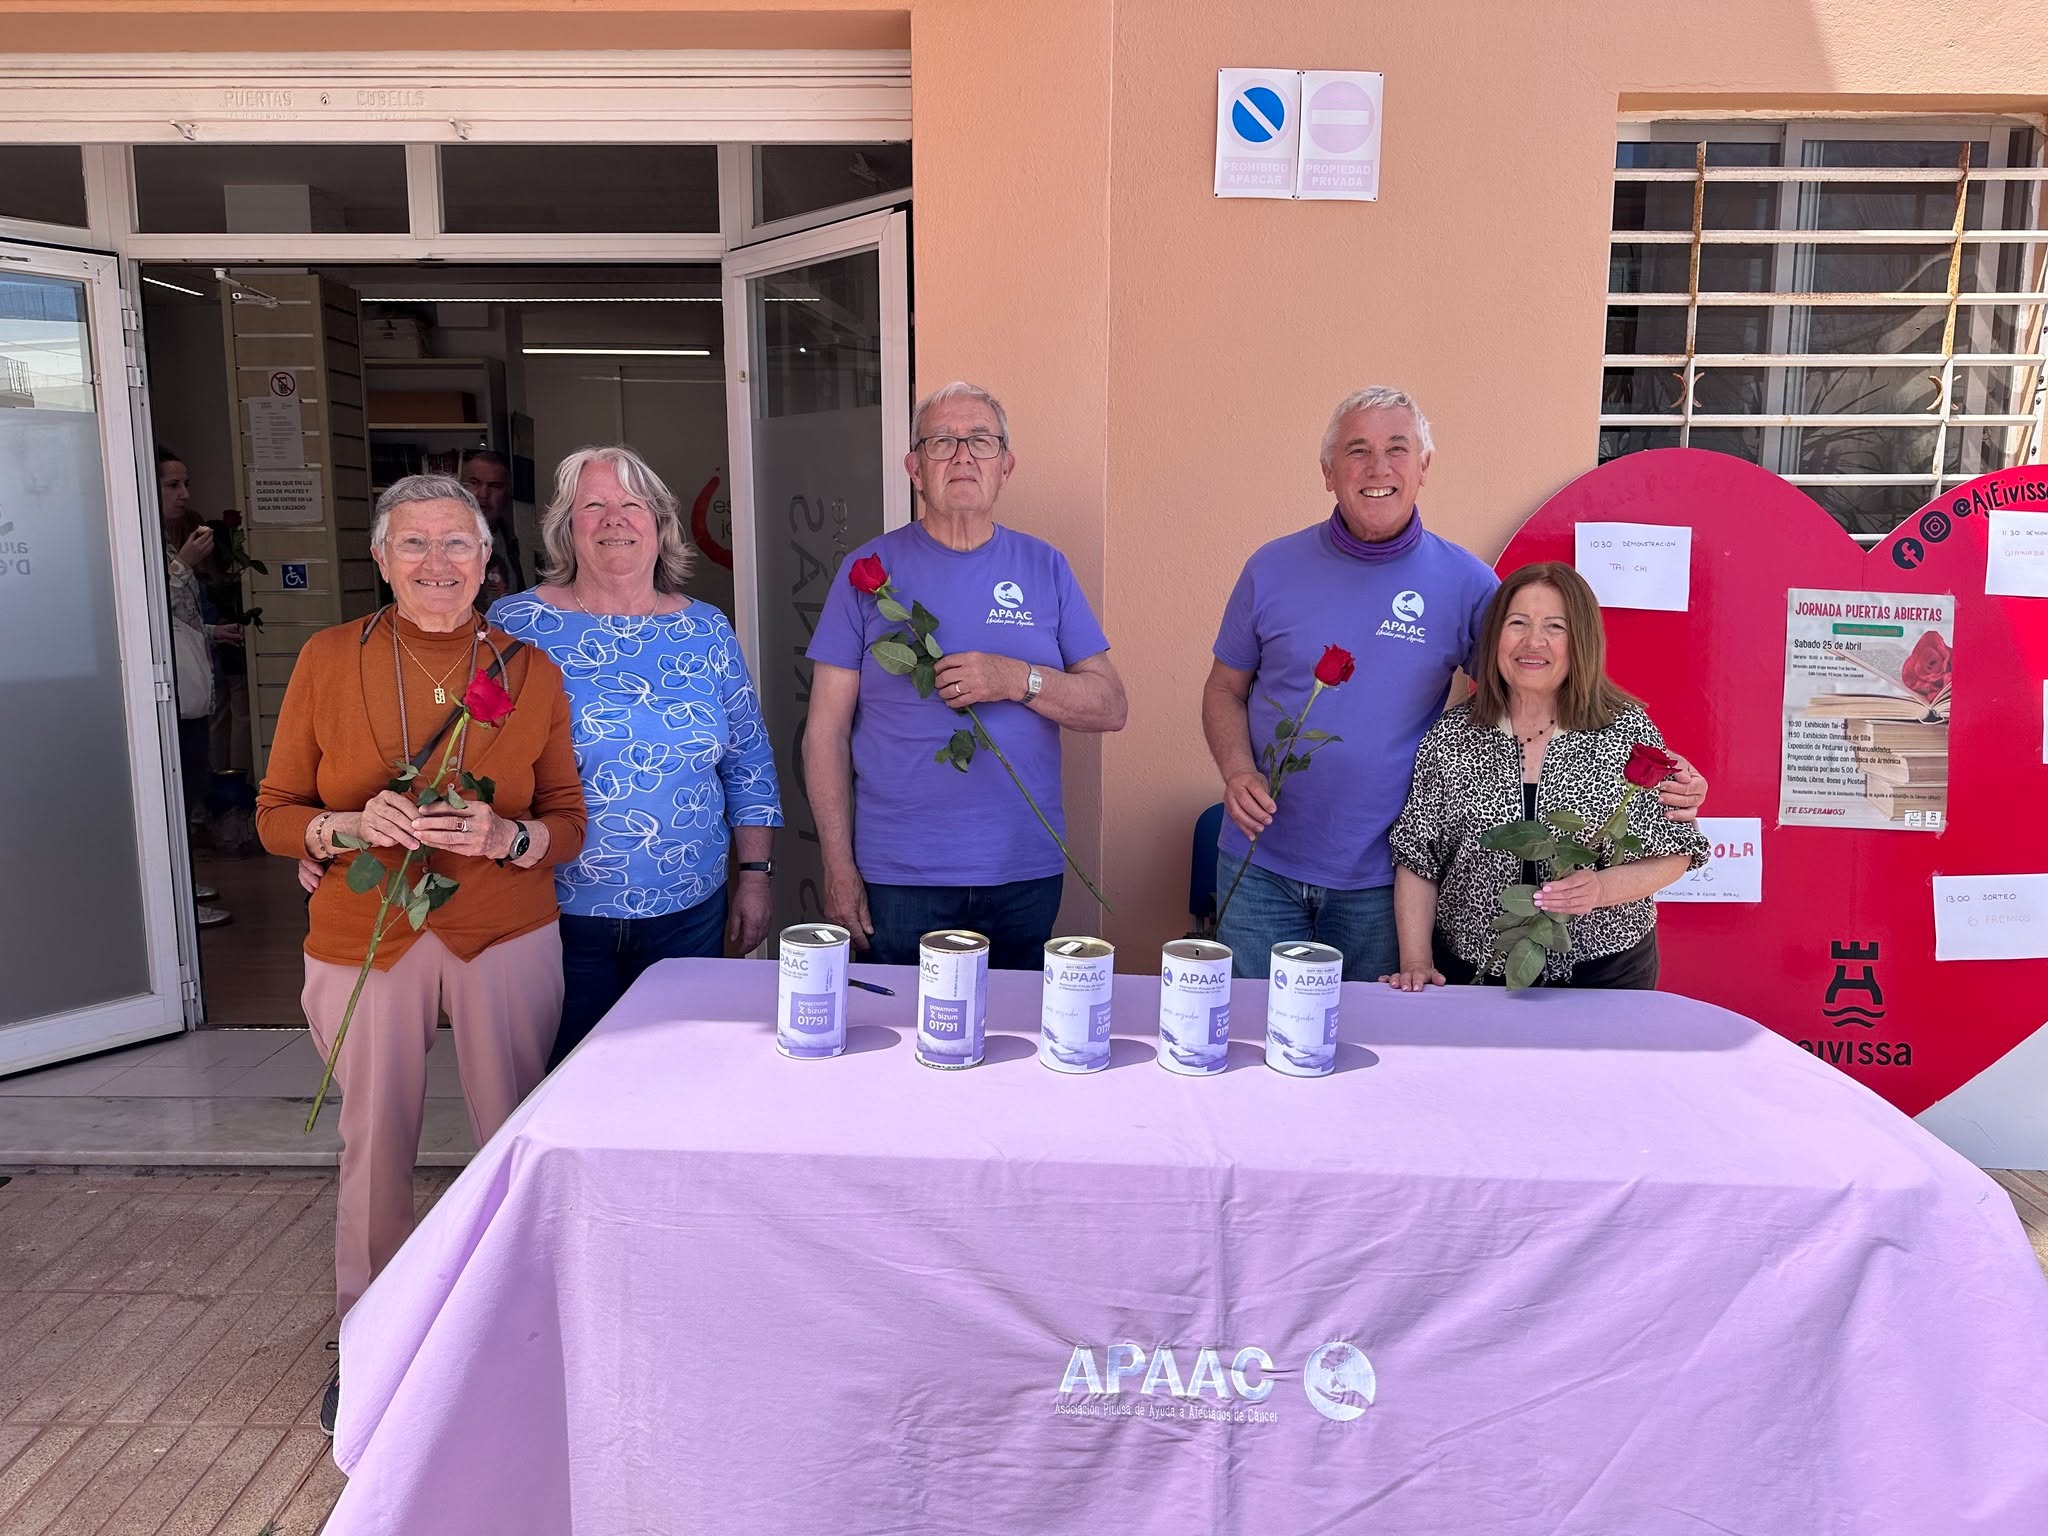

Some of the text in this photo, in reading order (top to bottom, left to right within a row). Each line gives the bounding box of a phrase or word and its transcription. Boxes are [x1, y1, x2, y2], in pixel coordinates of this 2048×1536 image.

[224, 90, 424, 108] PUERTAS CUBELLS
[1224, 161, 1288, 173] PROHIBIDO
[1306, 164, 1371, 175] PROPIEDAD
[1229, 174, 1282, 185] APARCAR
[1312, 176, 1363, 187] PRIVADA
[1952, 477, 2048, 518] @AjEiviss
[1609, 563, 1624, 571] TAI
[988, 608, 1032, 620] APAAC
[1796, 602, 1942, 622] JORNADA PUERTAS ABIERTAS
[1380, 620, 1426, 637] APAAC
[1822, 640, 1832, 650] 25
[1834, 641, 1843, 650] de
[1845, 641, 1862, 651] Abril
[1804, 721, 1829, 729] Exhibición
[1802, 732, 1828, 740] Exhibición
[1787, 743, 1813, 751] Exposición
[1787, 754, 1814, 762] Proyección
[1800, 808, 1845, 816] ESPERAMOS!
[1060, 970, 1106, 982] APAAC
[1180, 972, 1225, 985] APAAC
[1295, 974, 1339, 987] APAAC
[798, 1016, 828, 1026] 01791
[929, 1021, 958, 1032] 01791
[1059, 1342, 1274, 1400] APAAC
[1054, 1402, 1100, 1416] Asociación
[1134, 1404, 1145, 1417] de
[1149, 1405, 1175, 1420] Ayuda
[1179, 1409, 1185, 1418] a
[1235, 1410, 1244, 1422] de
[1247, 1408, 1278, 1423] Cáncer
